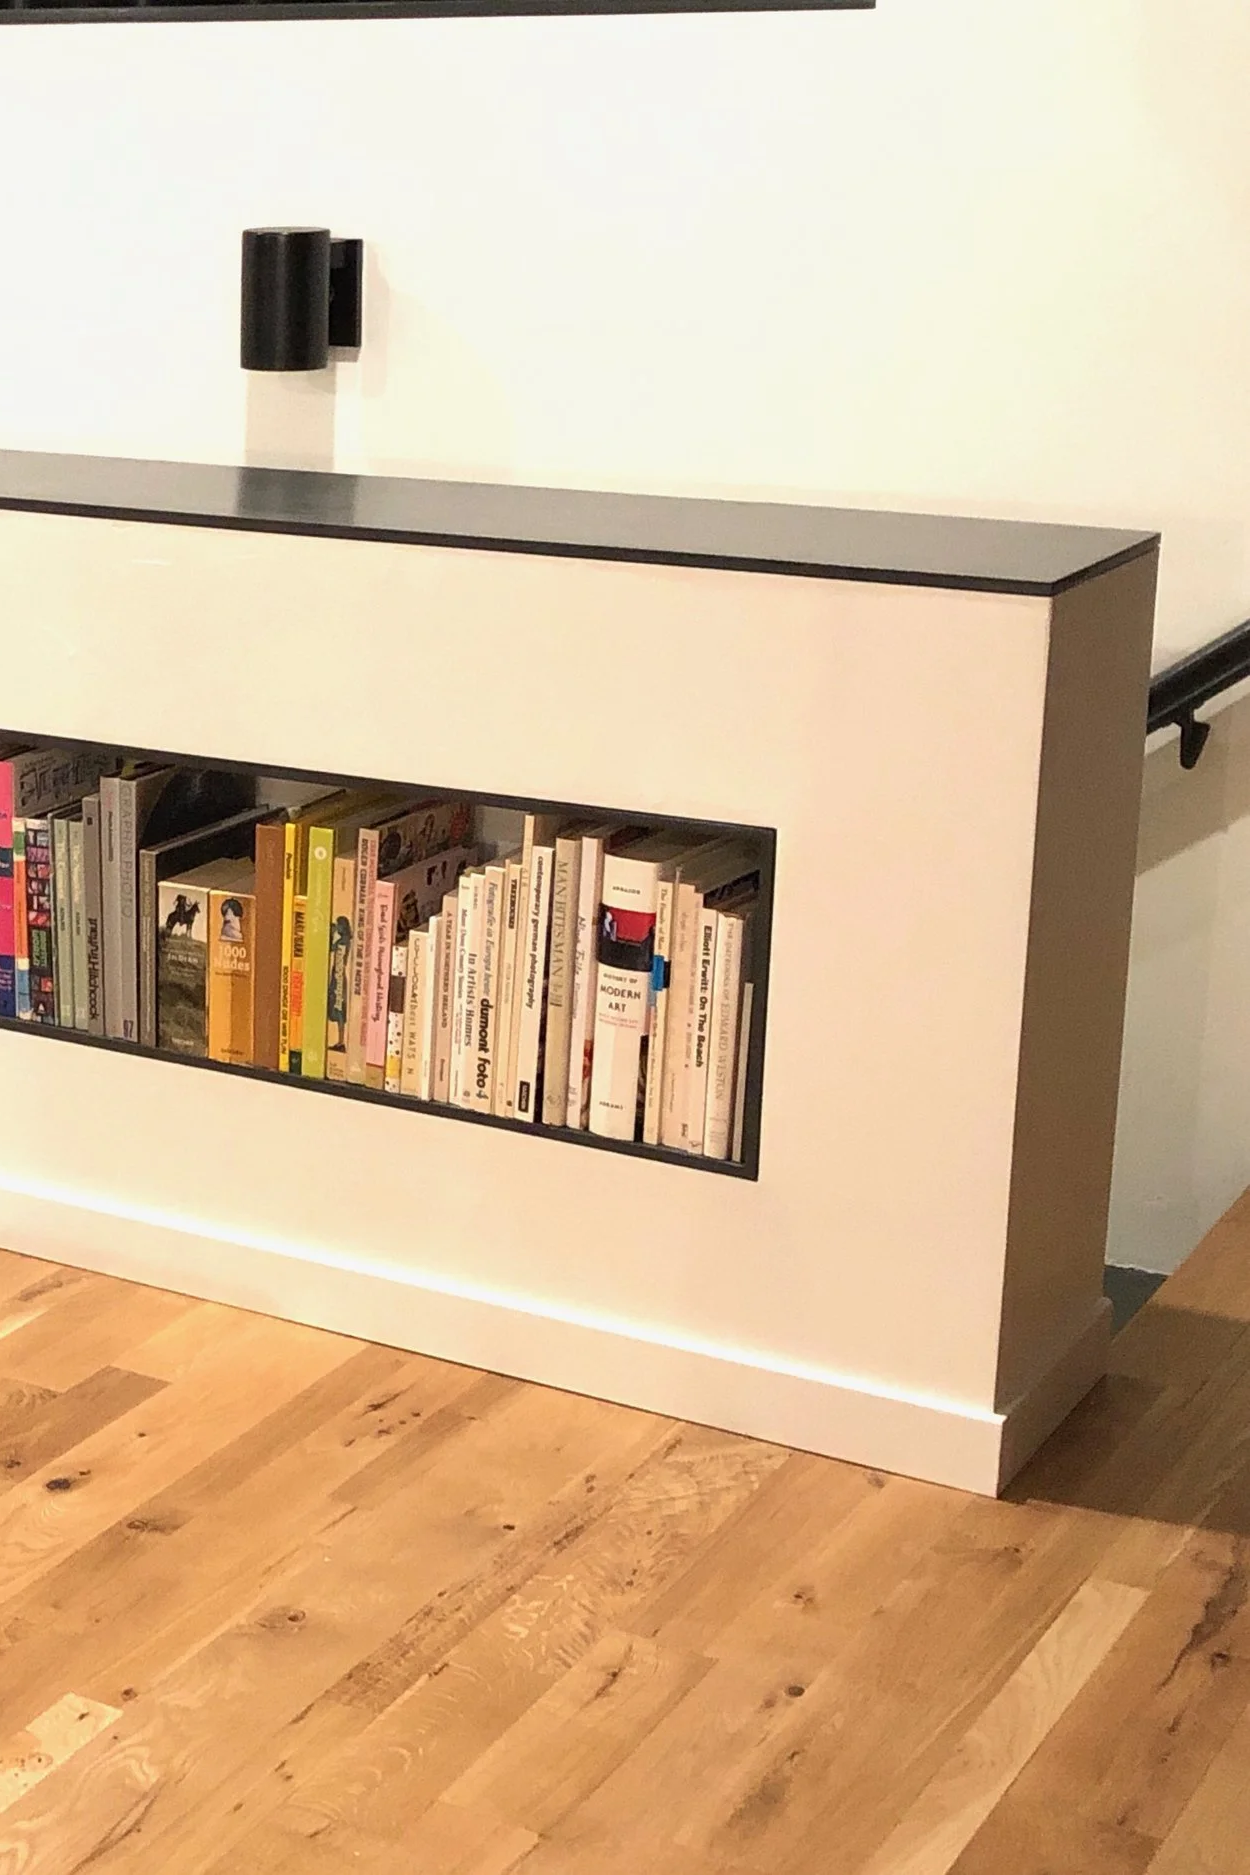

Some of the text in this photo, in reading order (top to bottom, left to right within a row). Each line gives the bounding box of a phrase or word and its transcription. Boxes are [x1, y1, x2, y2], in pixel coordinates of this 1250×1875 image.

[120, 783, 134, 856] GRAPHIS
[121, 860, 134, 919] PHOTO
[555, 860, 569, 899] MAN
[508, 879, 518, 930] TREEHOUSES
[356, 929, 365, 942] OF
[444, 941, 452, 950] IN
[525, 855, 546, 1009] contemporary german photography
[213, 957, 250, 972] Nudes
[219, 945, 247, 959] 1000
[356, 944, 364, 959] THE
[468, 952, 478, 965] In
[551, 940, 565, 978] MAN
[88, 961, 99, 1020] Hitchcock
[600, 984, 641, 1000] MODERN
[608, 1002, 626, 1013] ART
[695, 925, 713, 1068] Elliott Erwitt: On The Beach
[441, 994, 450, 1028] IRELAND
[465, 1009, 475, 1046] Homes
[477, 998, 493, 1053] dumont
[718, 1003, 731, 1051] EDWARD
[475, 1056, 491, 1088] foto
[714, 1054, 727, 1100] WESTON
